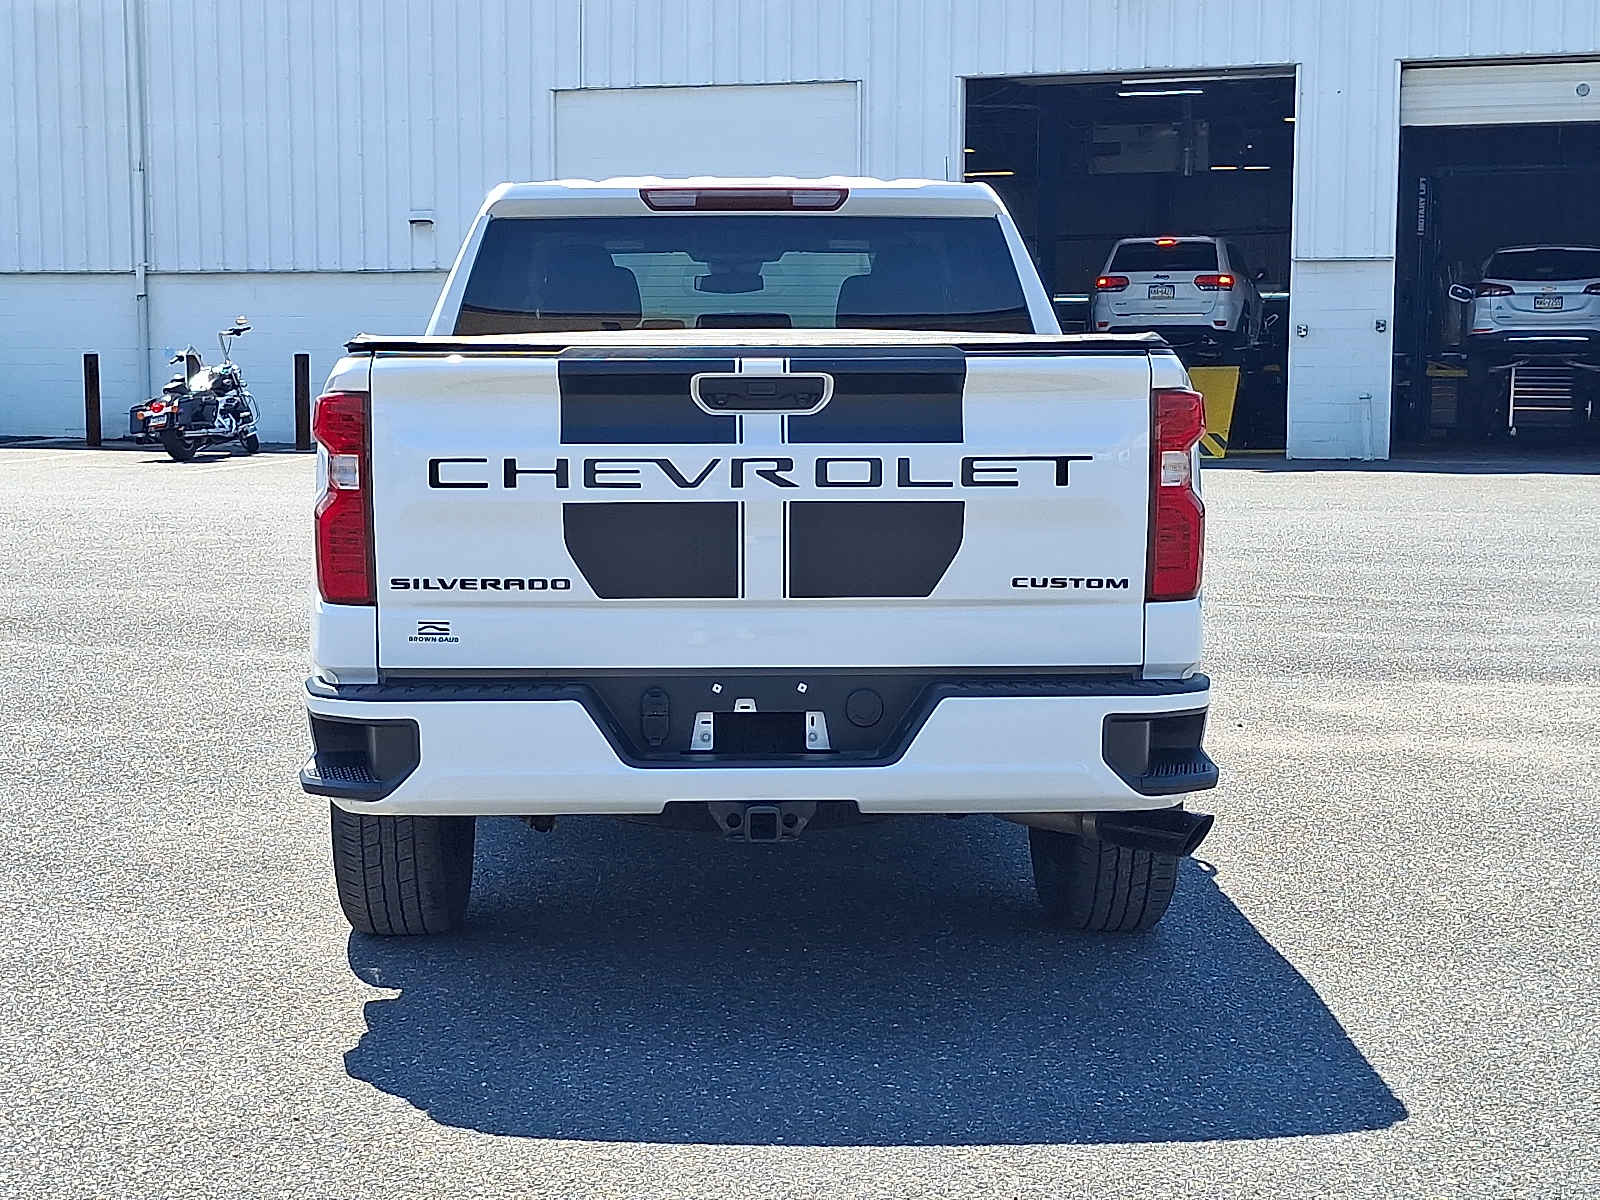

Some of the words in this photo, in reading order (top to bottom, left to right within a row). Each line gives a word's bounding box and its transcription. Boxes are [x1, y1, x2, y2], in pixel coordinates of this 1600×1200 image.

[1418, 177, 1427, 195] LIFT
[1417, 196, 1427, 231] ROTARY
[428, 455, 1093, 489] CHEVROLET
[390, 578, 571, 591] SILVERADO
[1011, 577, 1129, 589] CUSTOM
